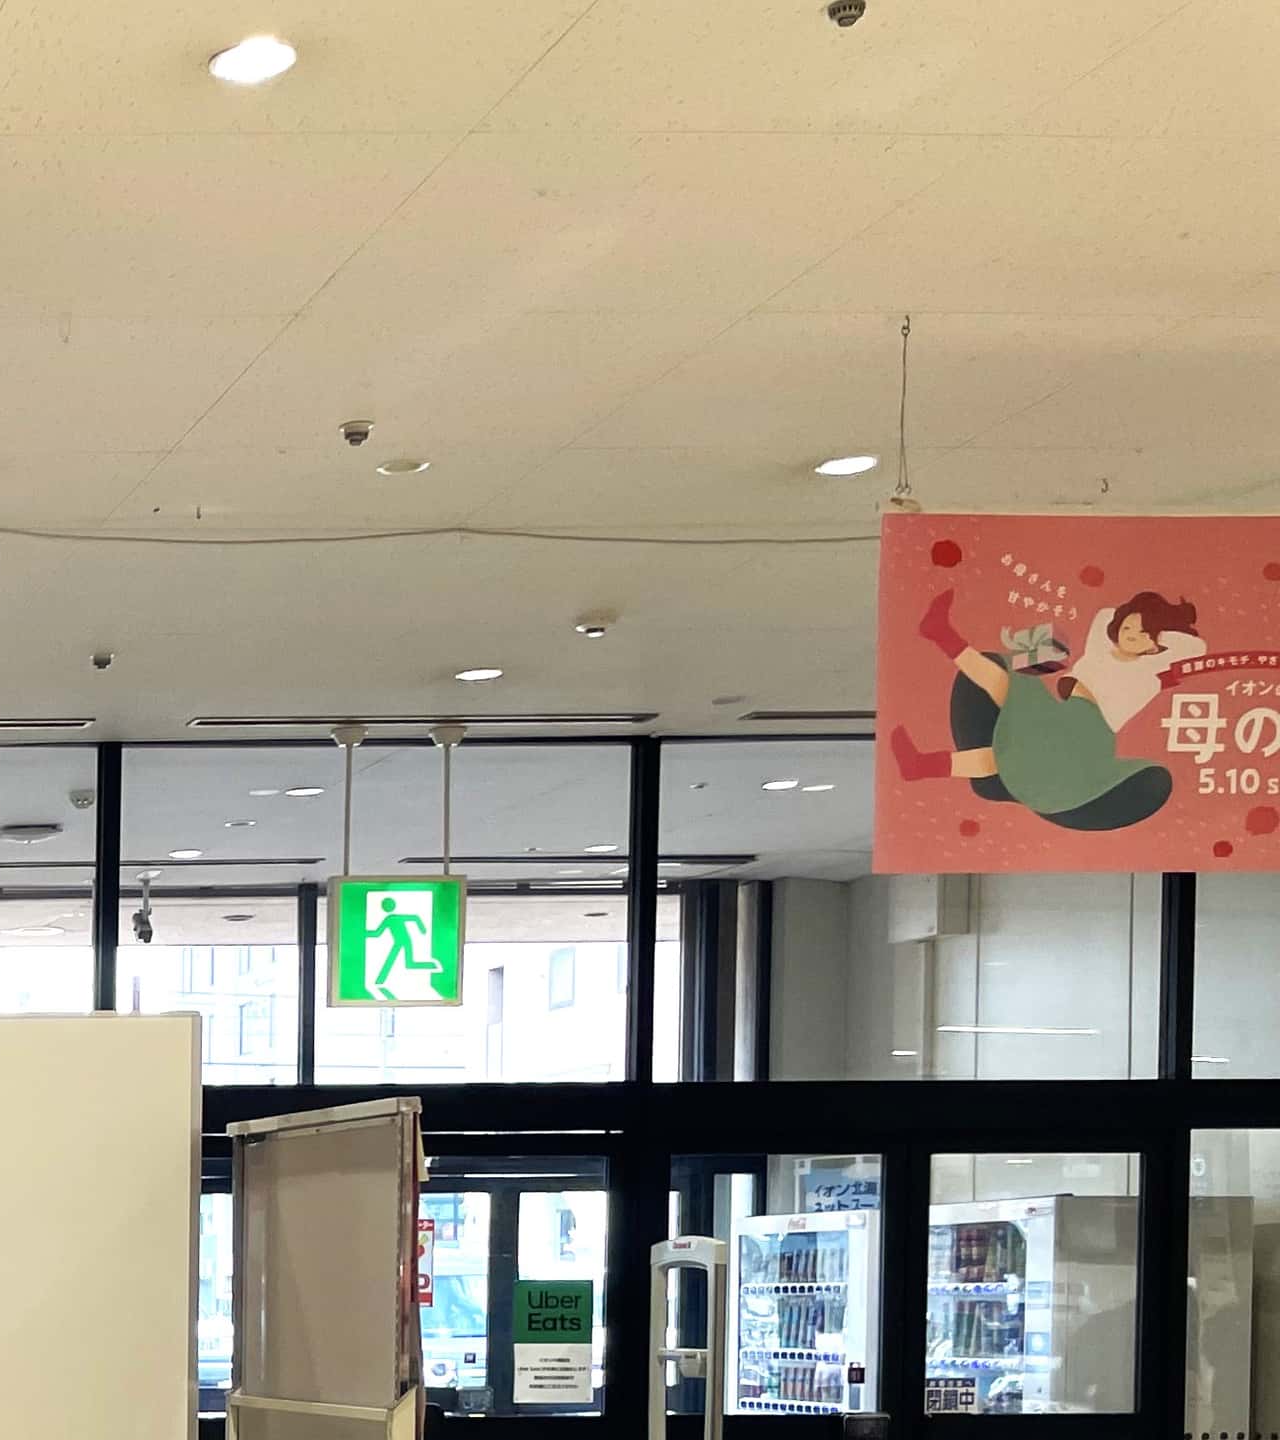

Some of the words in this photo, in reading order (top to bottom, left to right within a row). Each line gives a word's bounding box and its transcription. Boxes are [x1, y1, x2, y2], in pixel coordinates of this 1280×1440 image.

[1001, 553, 1067, 598] お母さんを
[1007, 590, 1078, 620] 甘やかそう
[1161, 693, 1280, 765] 母の
[1198, 768, 1260, 795] 5.10
[528, 1290, 582, 1309] Uber
[528, 1313, 582, 1332] Eats
